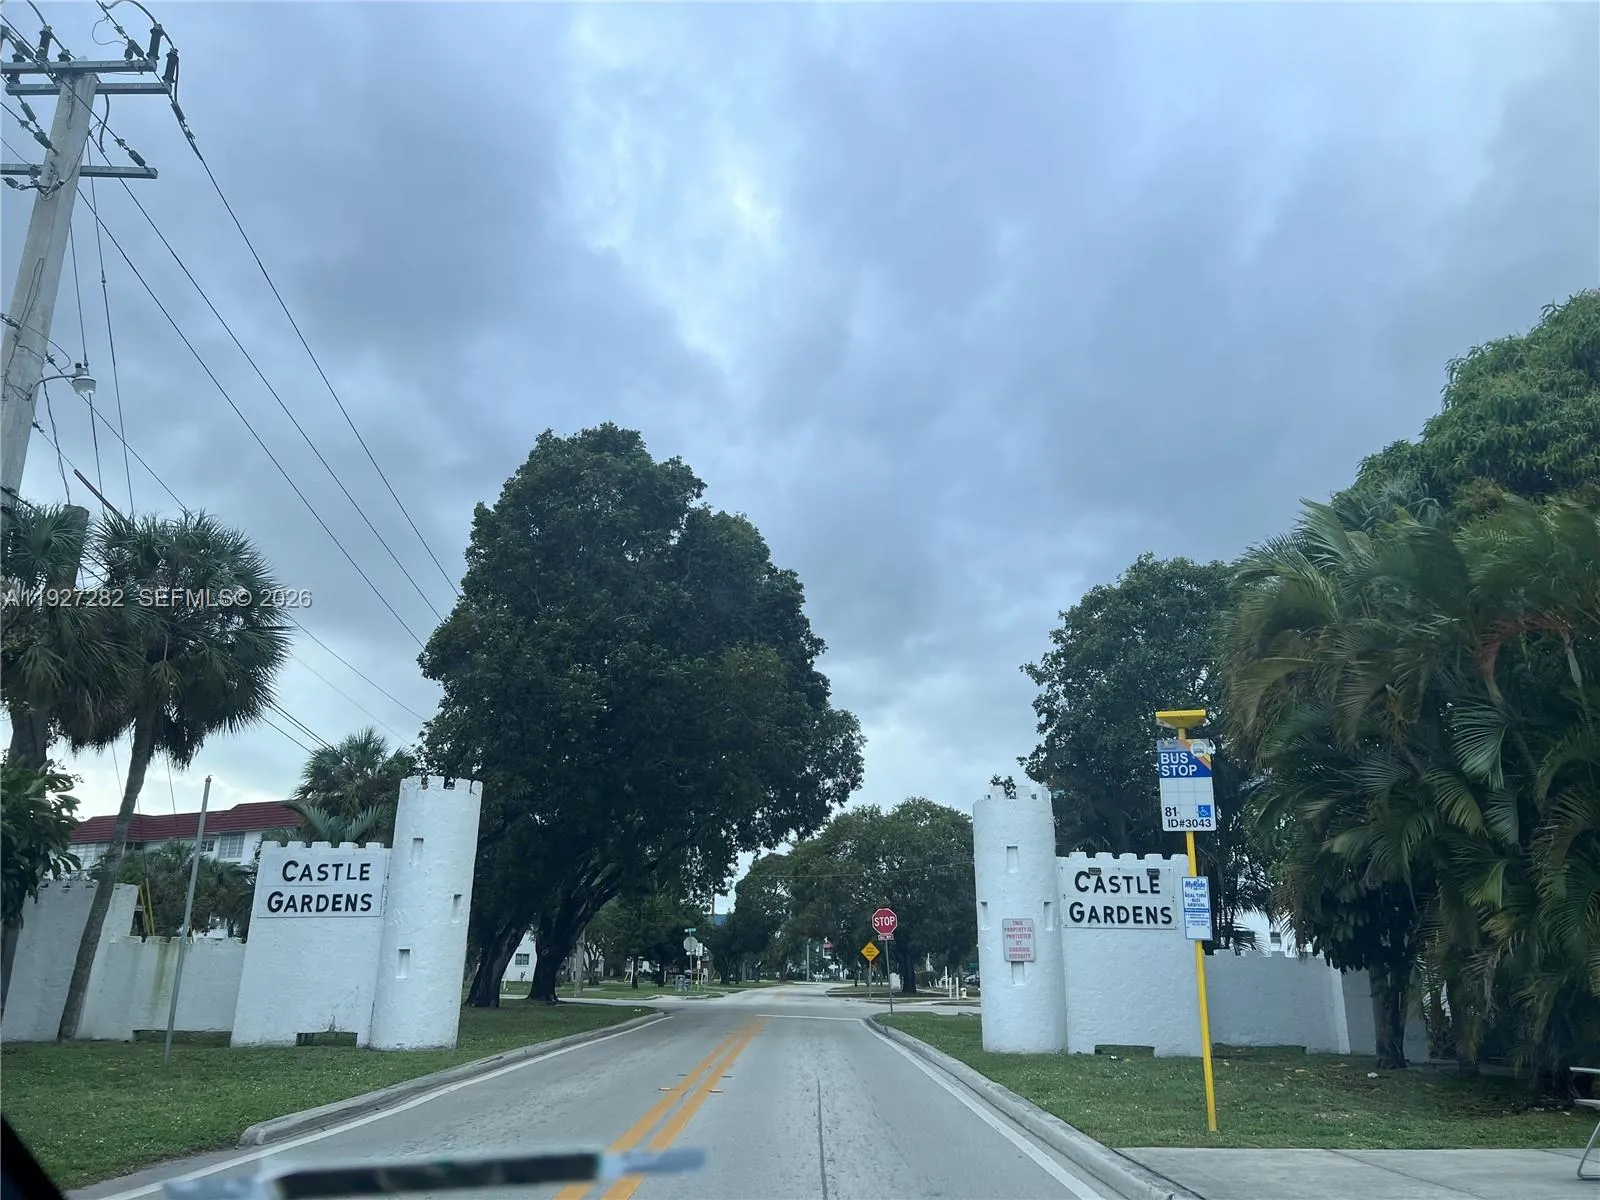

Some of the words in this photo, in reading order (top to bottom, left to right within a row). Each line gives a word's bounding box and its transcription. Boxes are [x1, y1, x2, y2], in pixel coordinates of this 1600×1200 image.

[1160, 752, 1188, 764] BUS
[1161, 764, 1198, 776] STOP
[1164, 806, 1178, 817] 81
[1167, 818, 1212, 828] ID#3043
[282, 859, 371, 882] CASTLE
[1074, 870, 1161, 894] CASTLE
[267, 890, 373, 913] GARDENS
[1069, 901, 1173, 924] GARDENS
[874, 916, 895, 927] STOP
